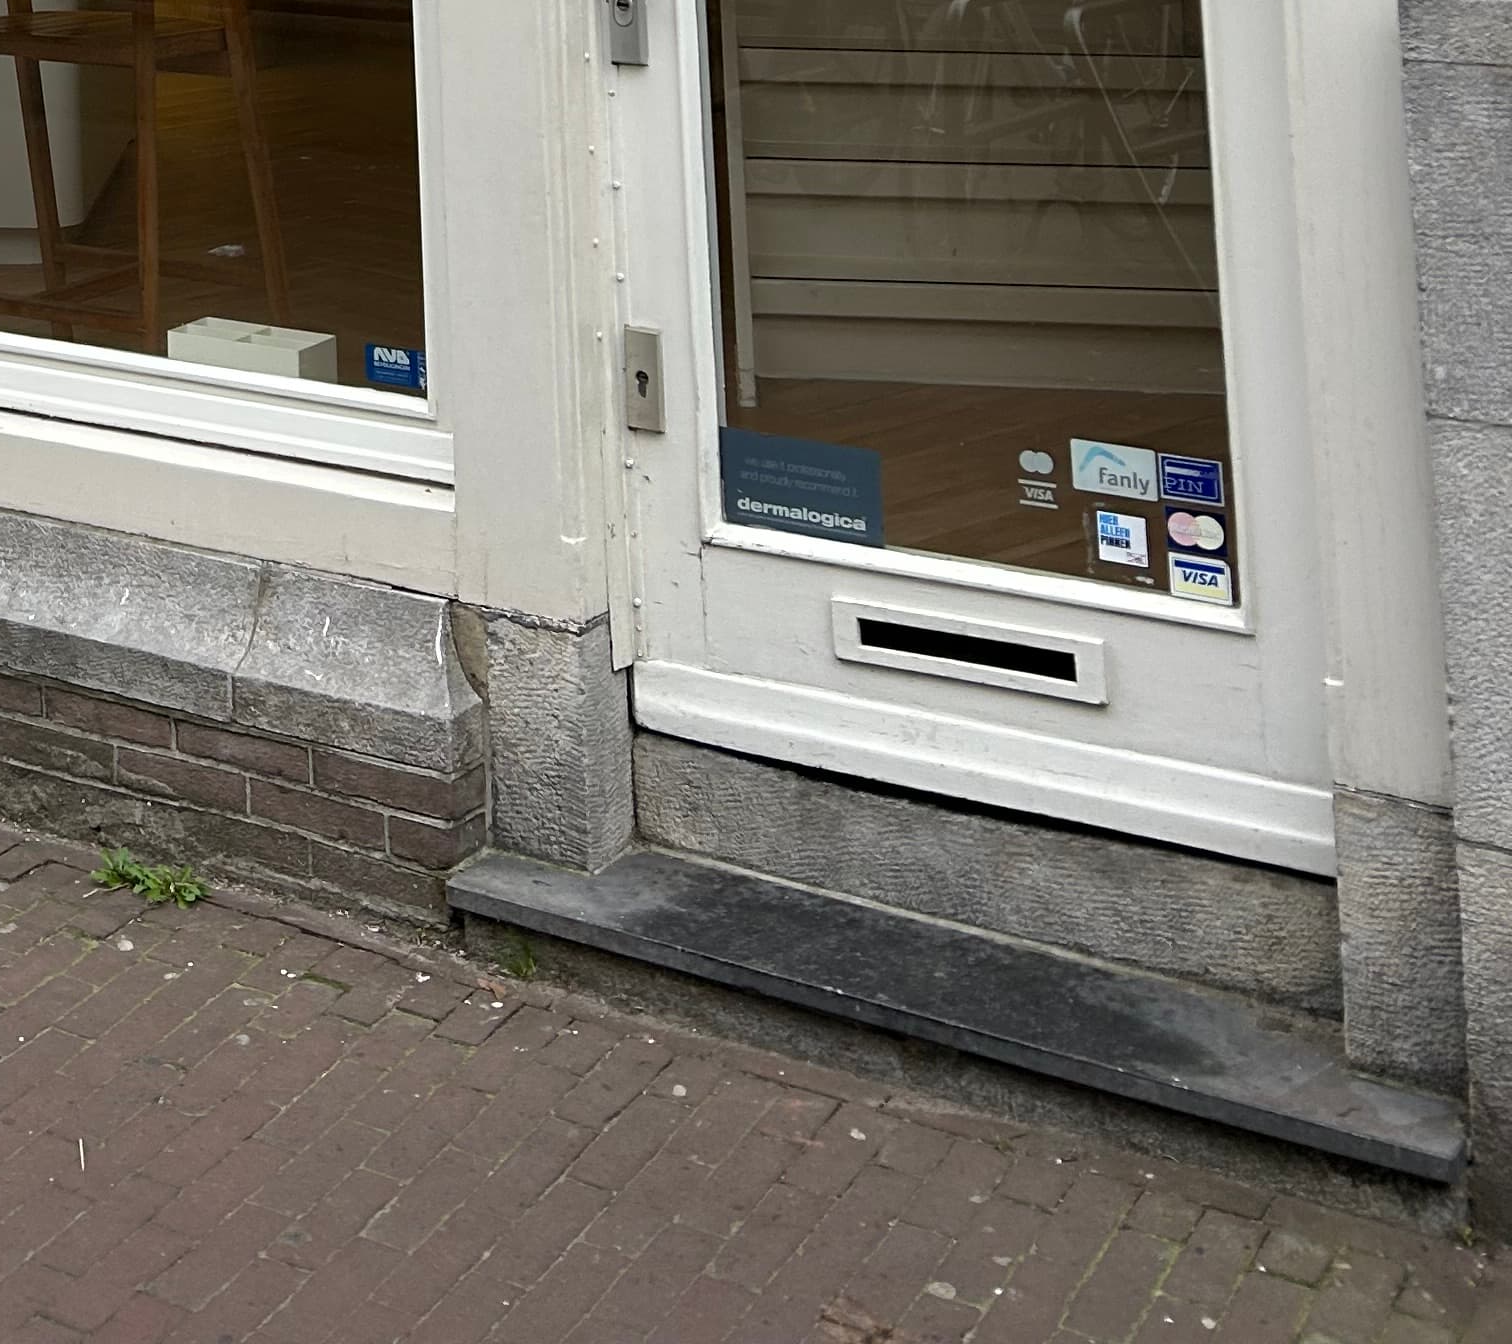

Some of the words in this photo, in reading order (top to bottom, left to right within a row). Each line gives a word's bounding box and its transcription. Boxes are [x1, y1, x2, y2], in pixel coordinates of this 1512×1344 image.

[1098, 466, 1150, 496] fanly
[1164, 476, 1204, 493] PIN
[1023, 486, 1054, 502] VISA
[737, 497, 867, 532] dermalogica
[1181, 569, 1219, 588] VISA
